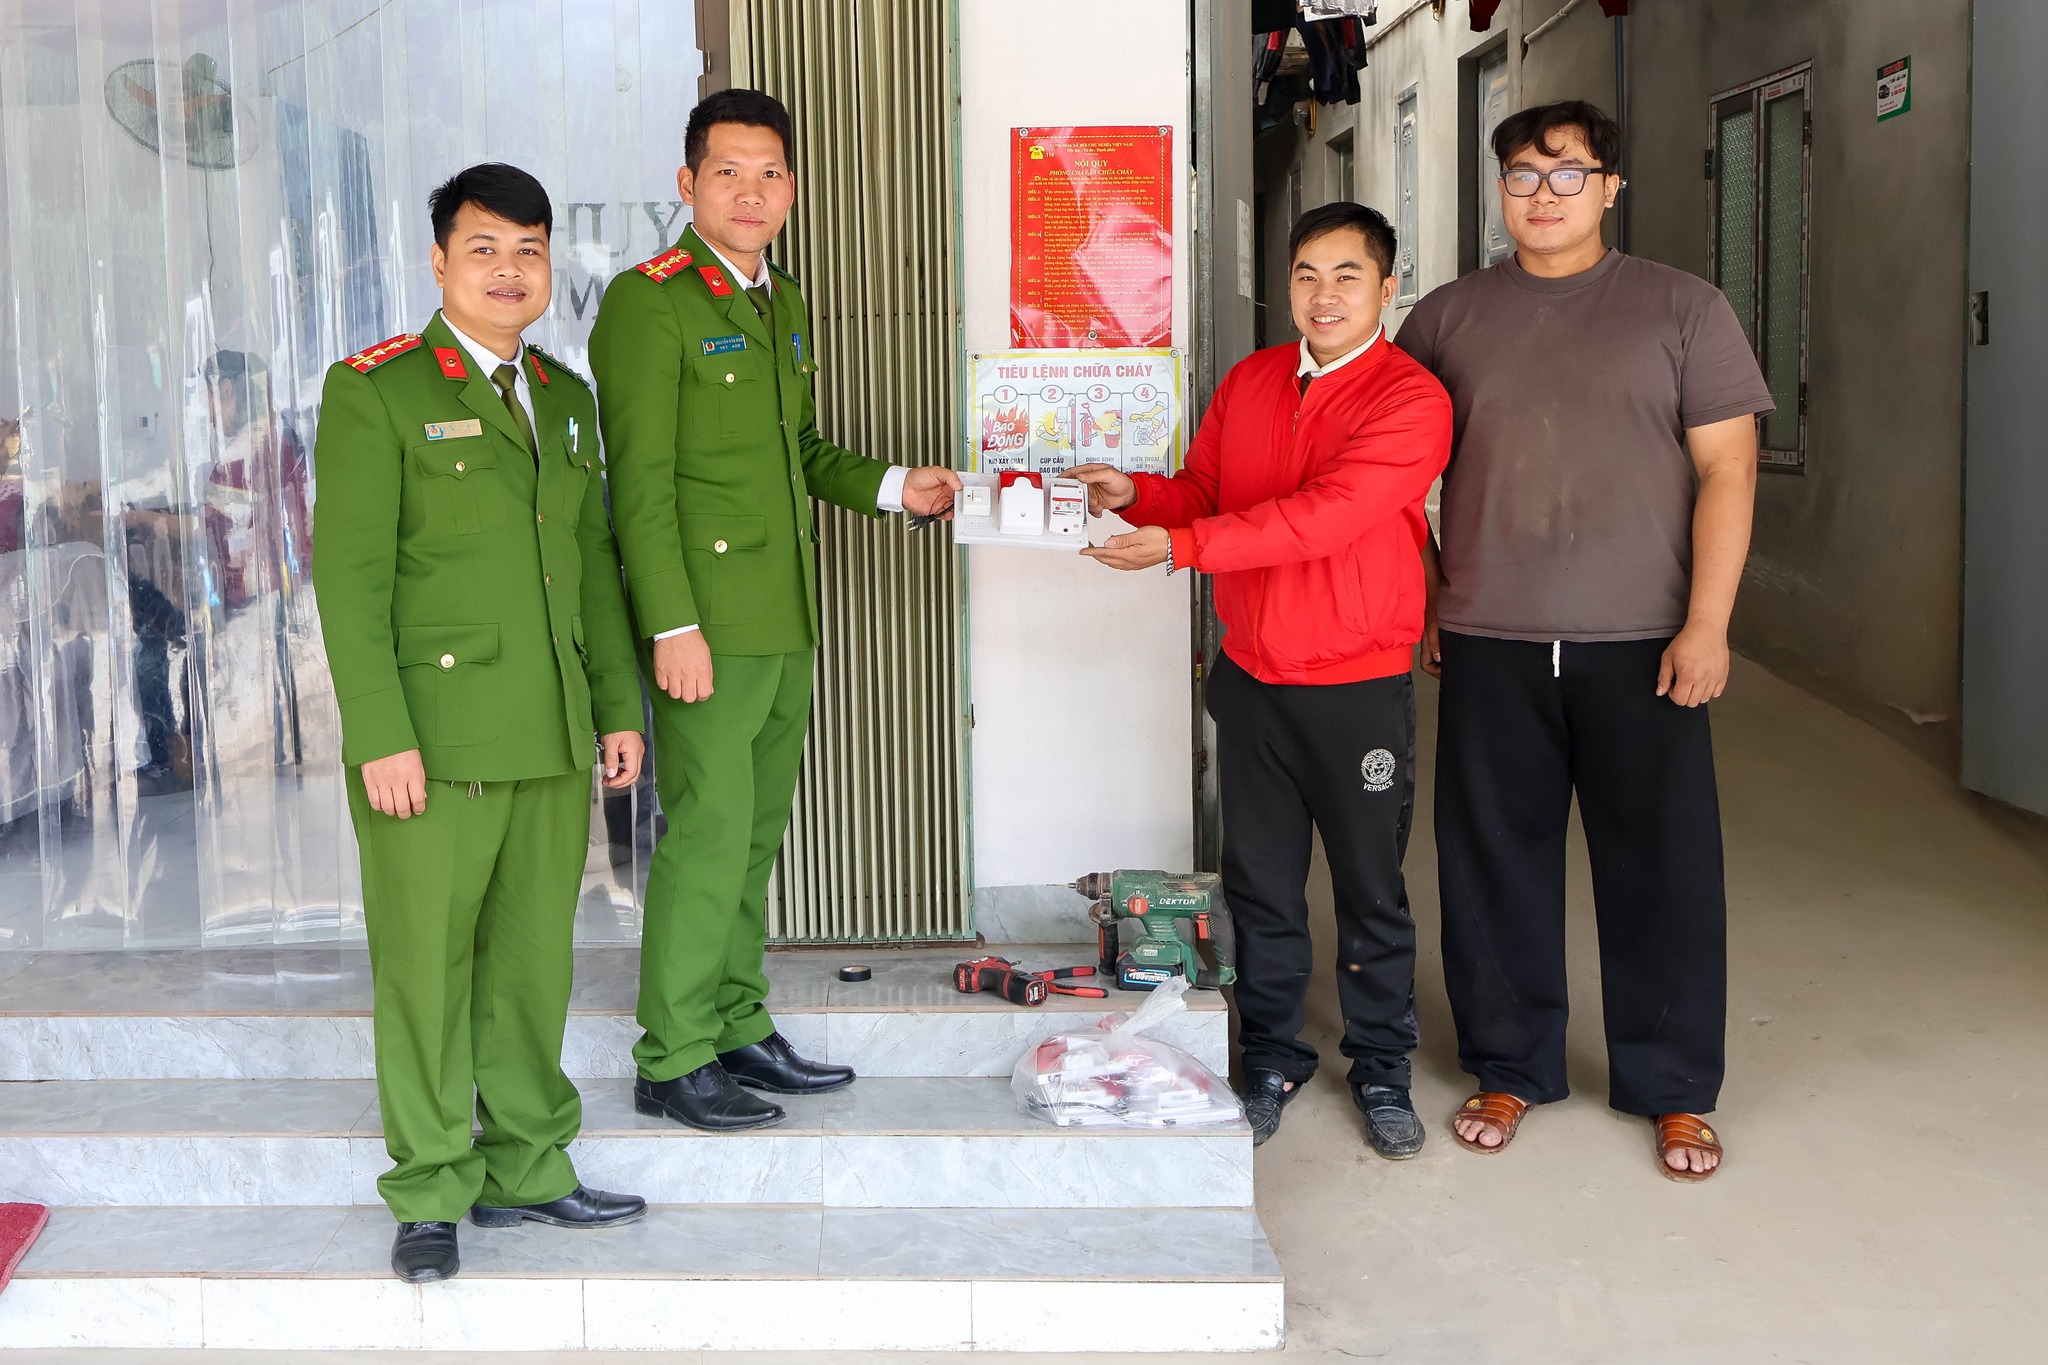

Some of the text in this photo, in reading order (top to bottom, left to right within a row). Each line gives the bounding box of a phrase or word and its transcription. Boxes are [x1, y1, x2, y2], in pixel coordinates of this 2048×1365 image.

[1074, 159, 1108, 168] NỘI QUY
[997, 362, 1153, 381] TIÊU LỆNH CHỮA CHÁY
[1002, 388, 1009, 401] 1
[1047, 388, 1057, 400] 2
[1094, 387, 1103, 400] 3
[1140, 387, 1150, 399] 4
[987, 432, 1024, 452] ĐỘNG
[1363, 778, 1394, 791] VERSACE
